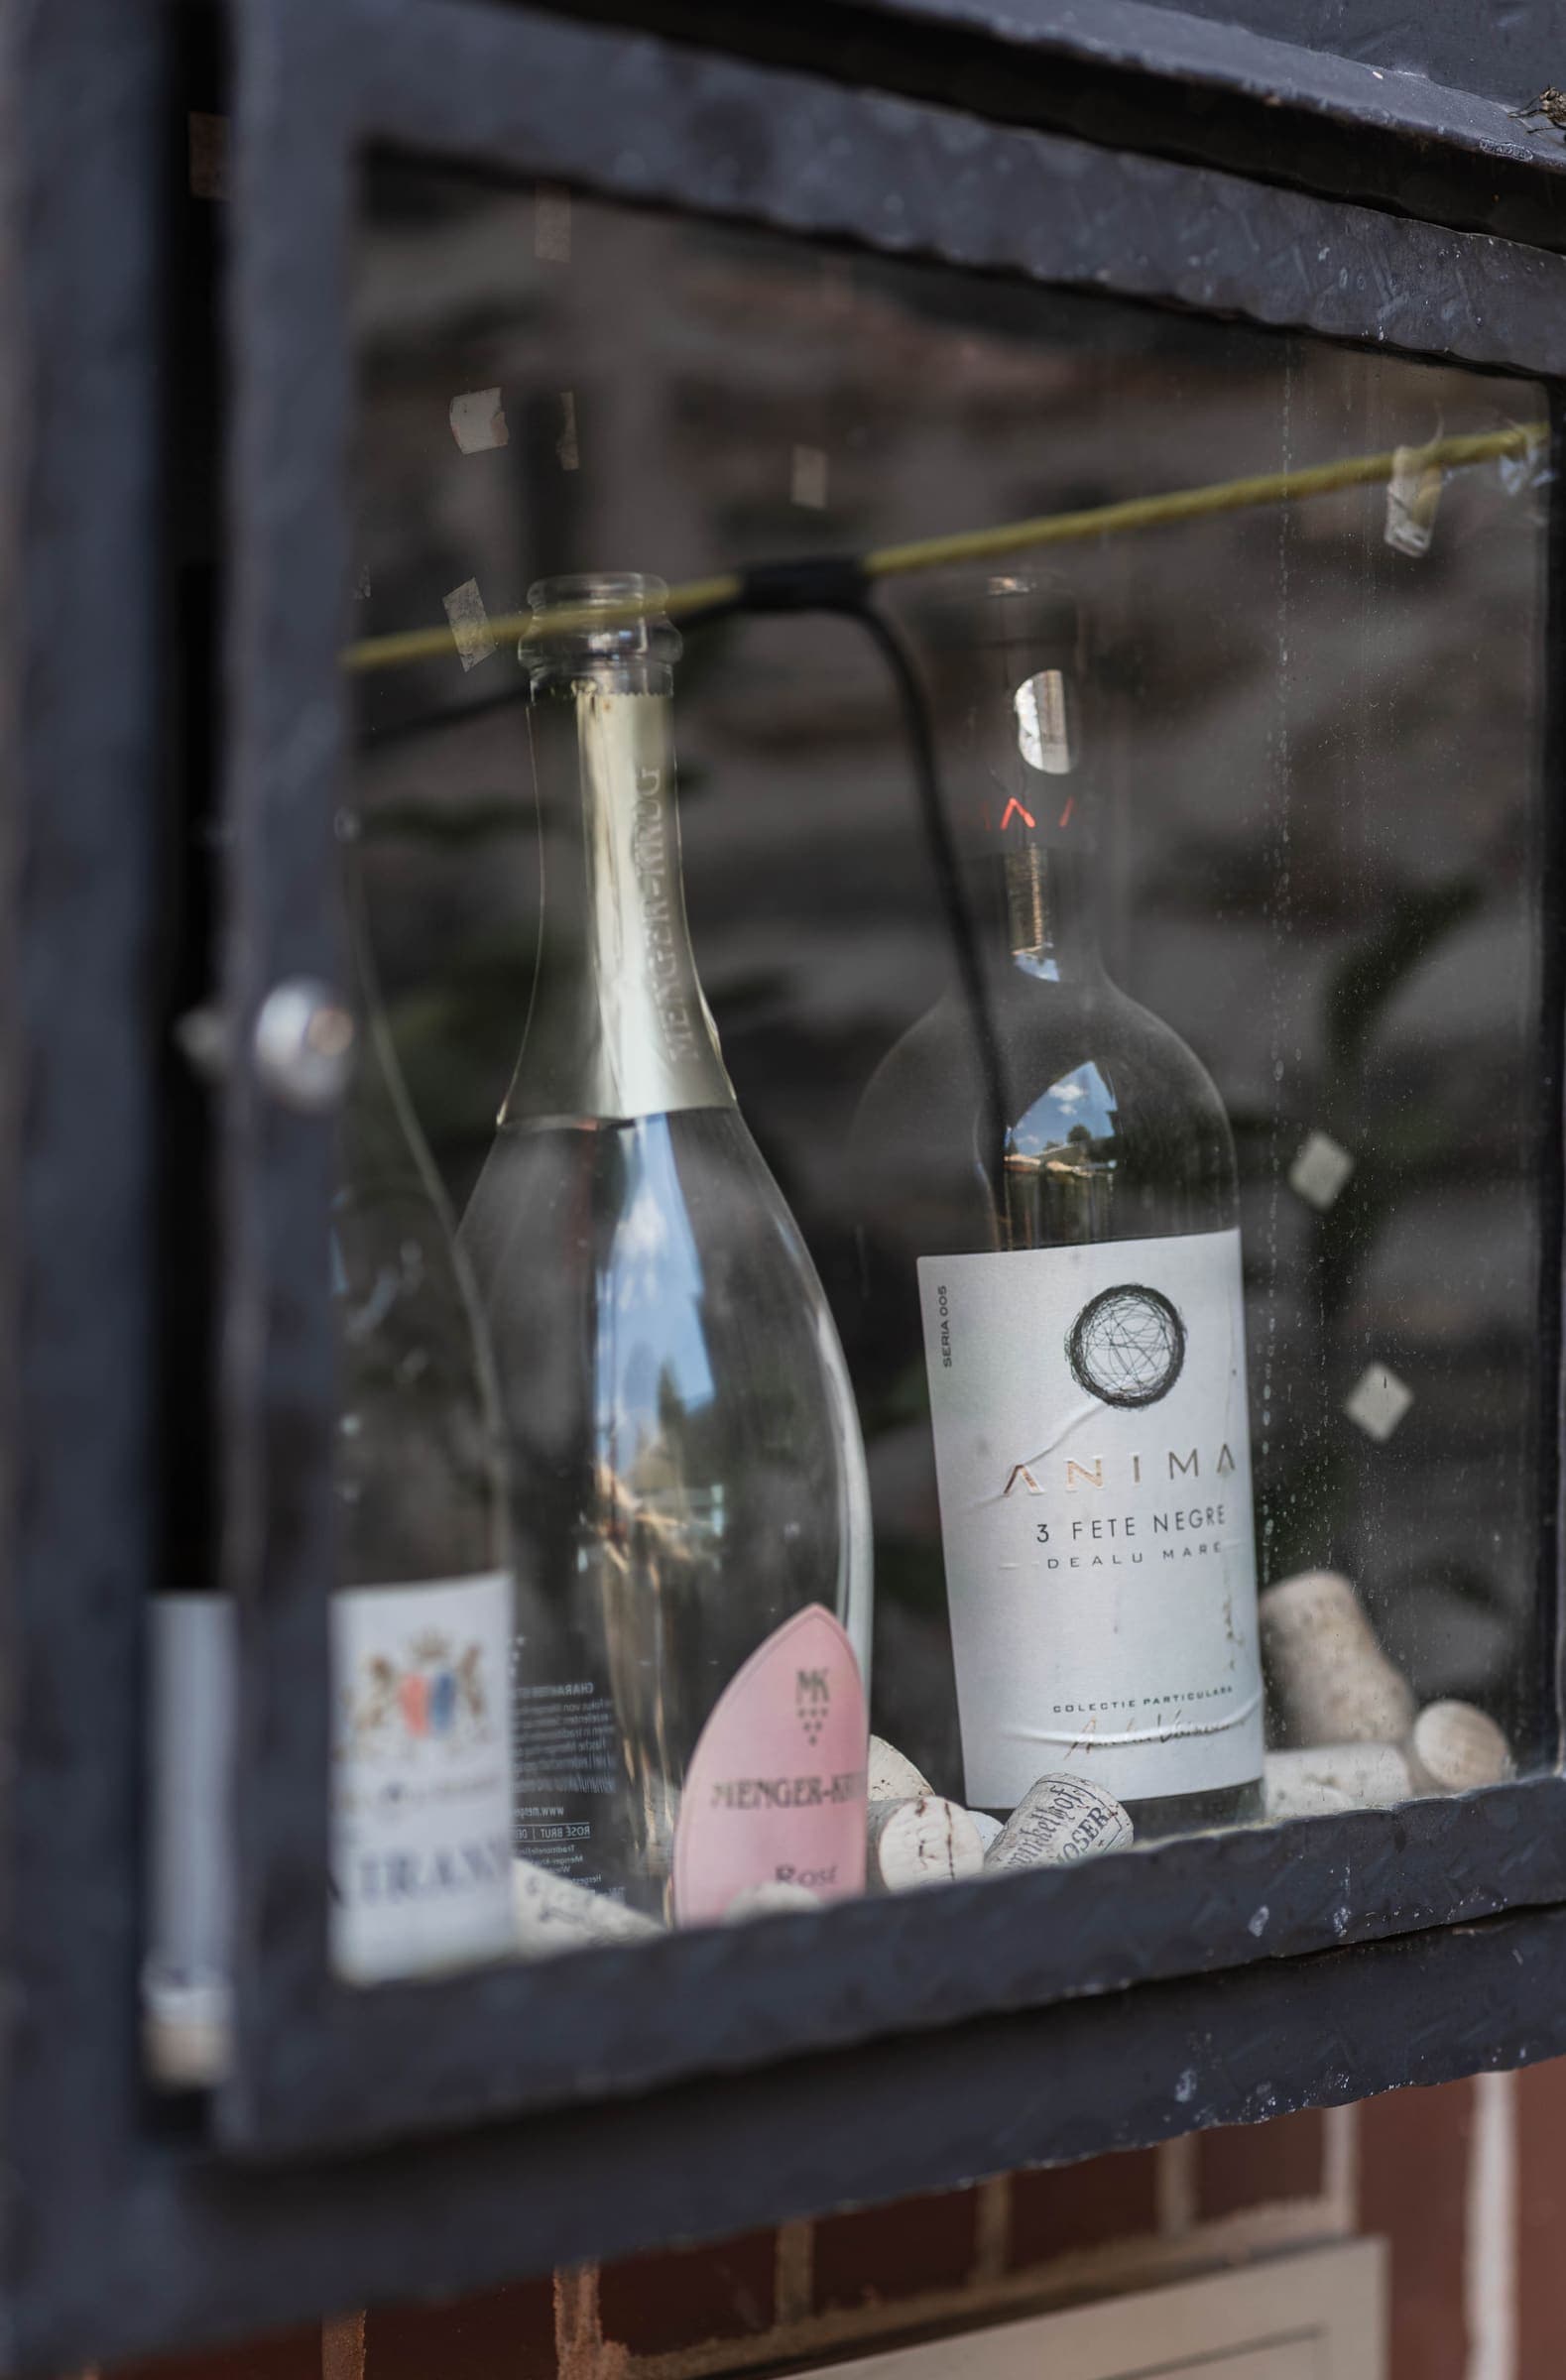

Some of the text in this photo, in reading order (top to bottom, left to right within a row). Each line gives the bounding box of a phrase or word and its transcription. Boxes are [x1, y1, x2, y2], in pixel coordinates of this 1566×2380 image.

[940, 1318, 952, 1368] SERIA
[1003, 1443, 1237, 1496] ANIMA
[1036, 1504, 1226, 1542] 3 FETE NEGRE
[1046, 1541, 1222, 1570] DEALU MARE
[1052, 1700, 1137, 1714] COLECTIE
